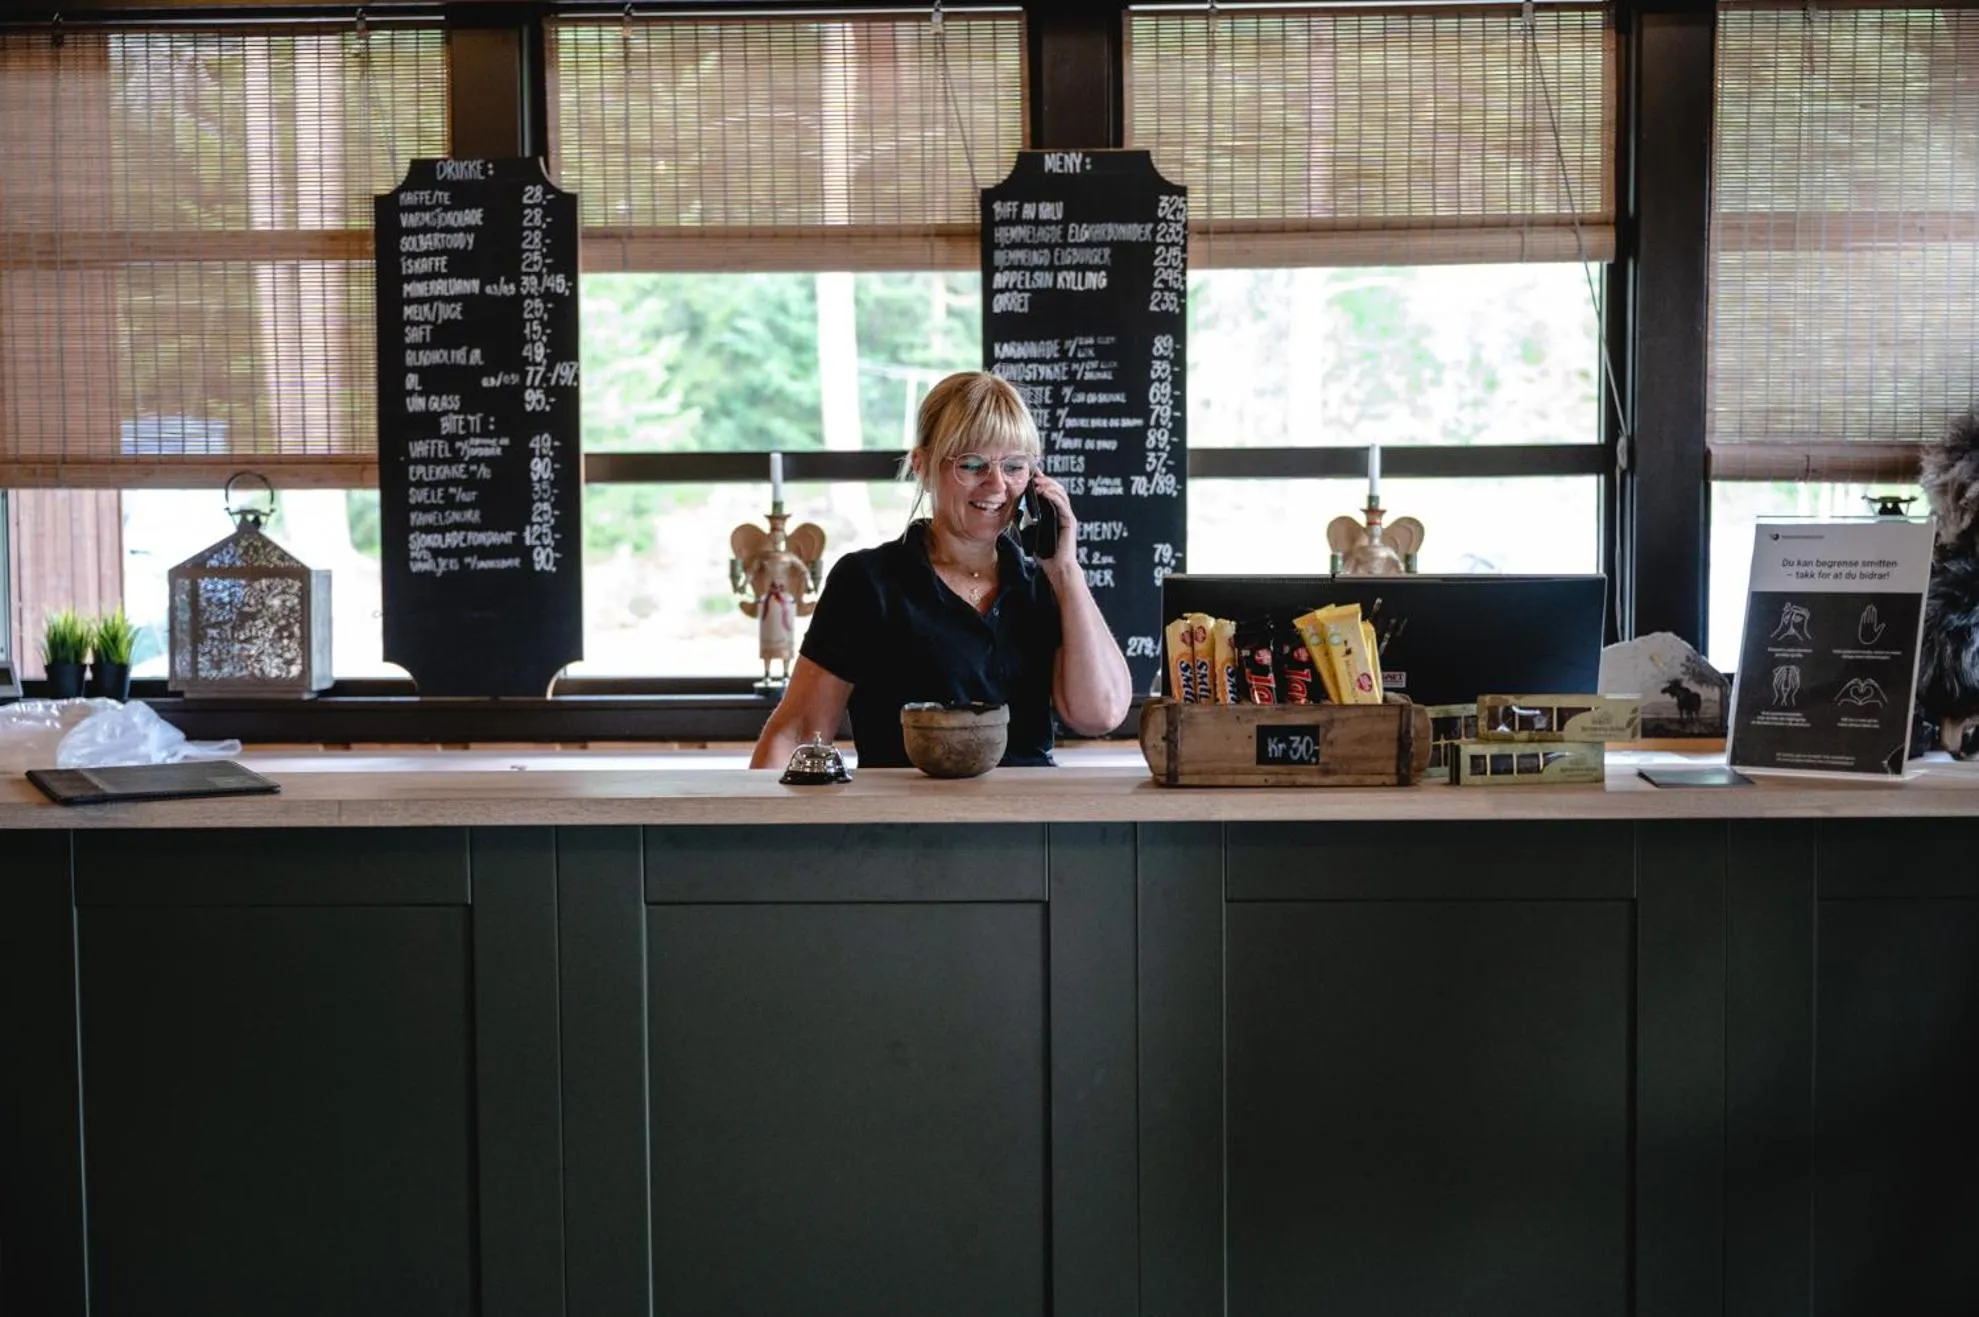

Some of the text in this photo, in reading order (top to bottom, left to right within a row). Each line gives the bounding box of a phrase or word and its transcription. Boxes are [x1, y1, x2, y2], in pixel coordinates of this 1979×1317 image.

[1044, 153, 1092, 173] MENY:
[1056, 270, 1108, 291] KYLLING
[404, 324, 433, 344] SAFT
[1782, 558, 1795, 567] Du
[1797, 558, 1814, 567] kan
[1815, 559, 1859, 570] begrense
[1796, 571, 1815, 579] takk
[1818, 571, 1831, 580] for
[1833, 572, 1843, 580] at
[1845, 571, 1857, 580] du
[1267, 737, 1288, 757] Kr
